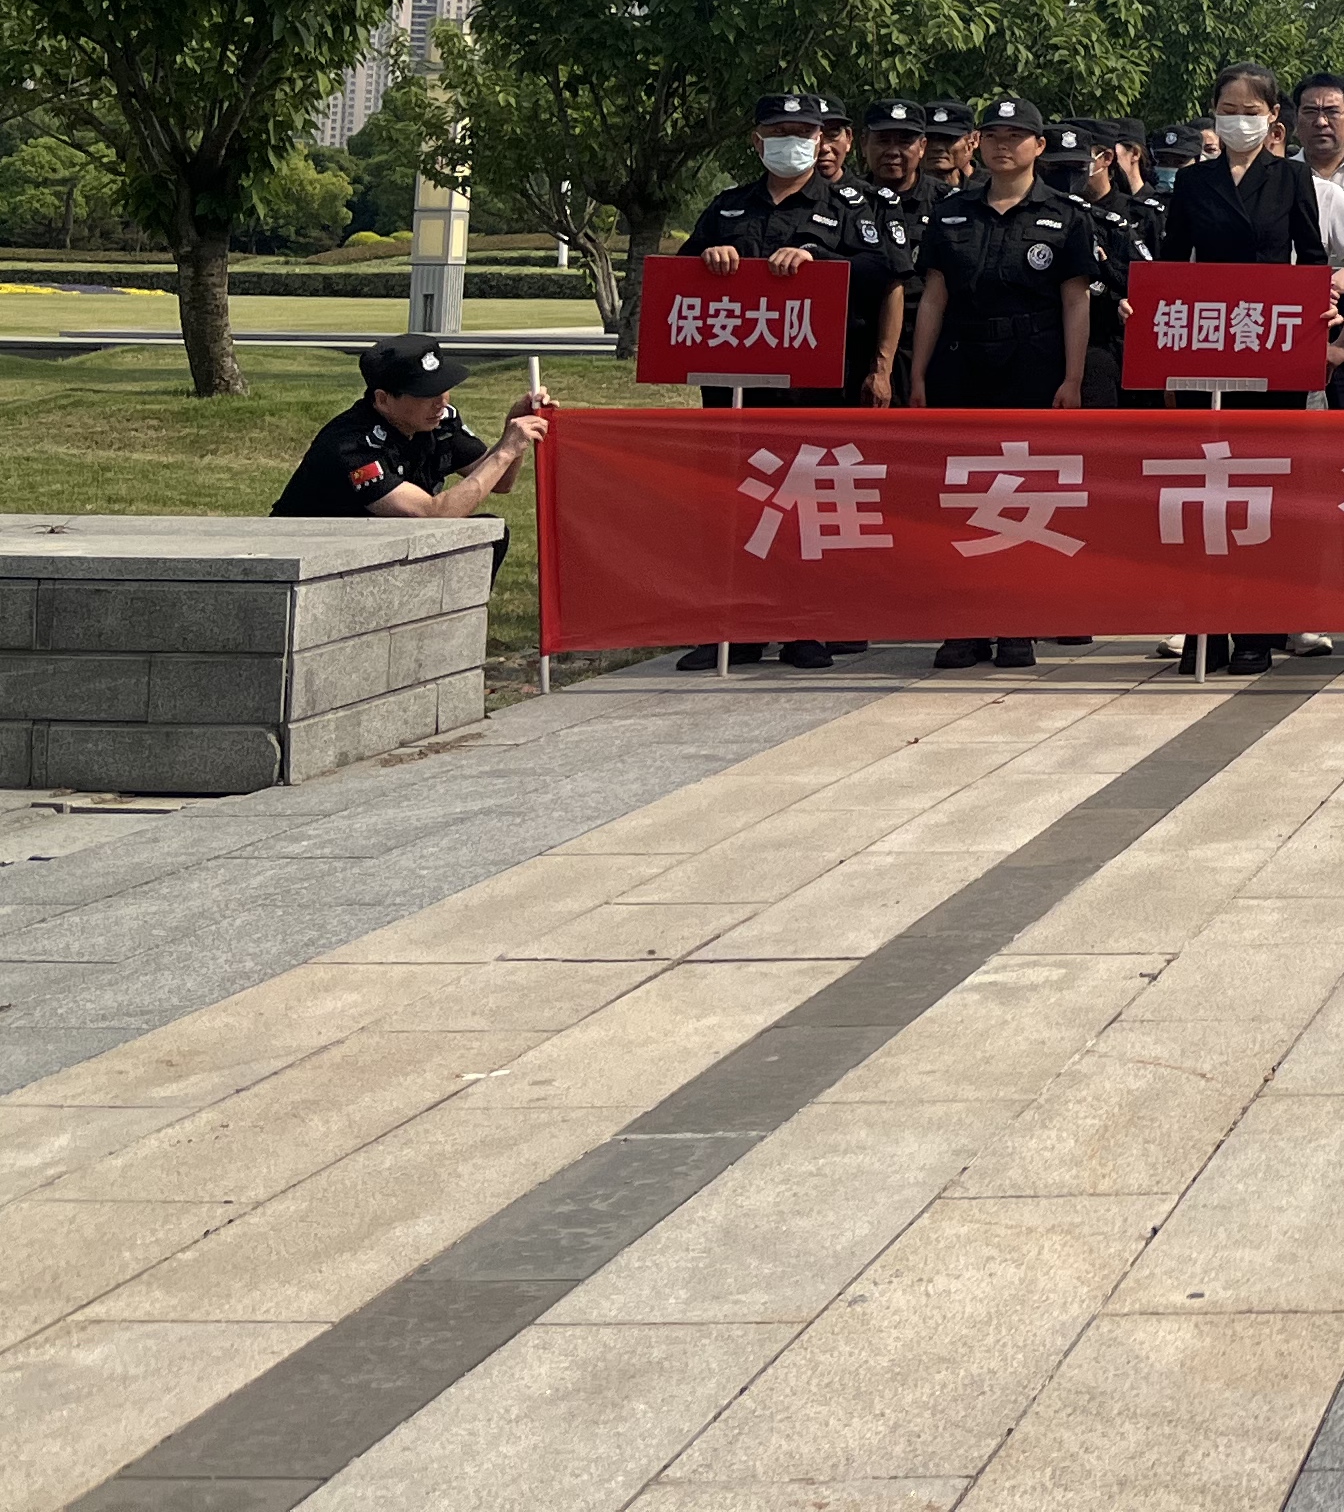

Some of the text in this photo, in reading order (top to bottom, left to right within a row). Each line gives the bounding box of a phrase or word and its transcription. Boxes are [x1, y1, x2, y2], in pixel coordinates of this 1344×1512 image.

[667, 294, 818, 349] 保安大队
[1153, 299, 1303, 352] 锦园餐厅
